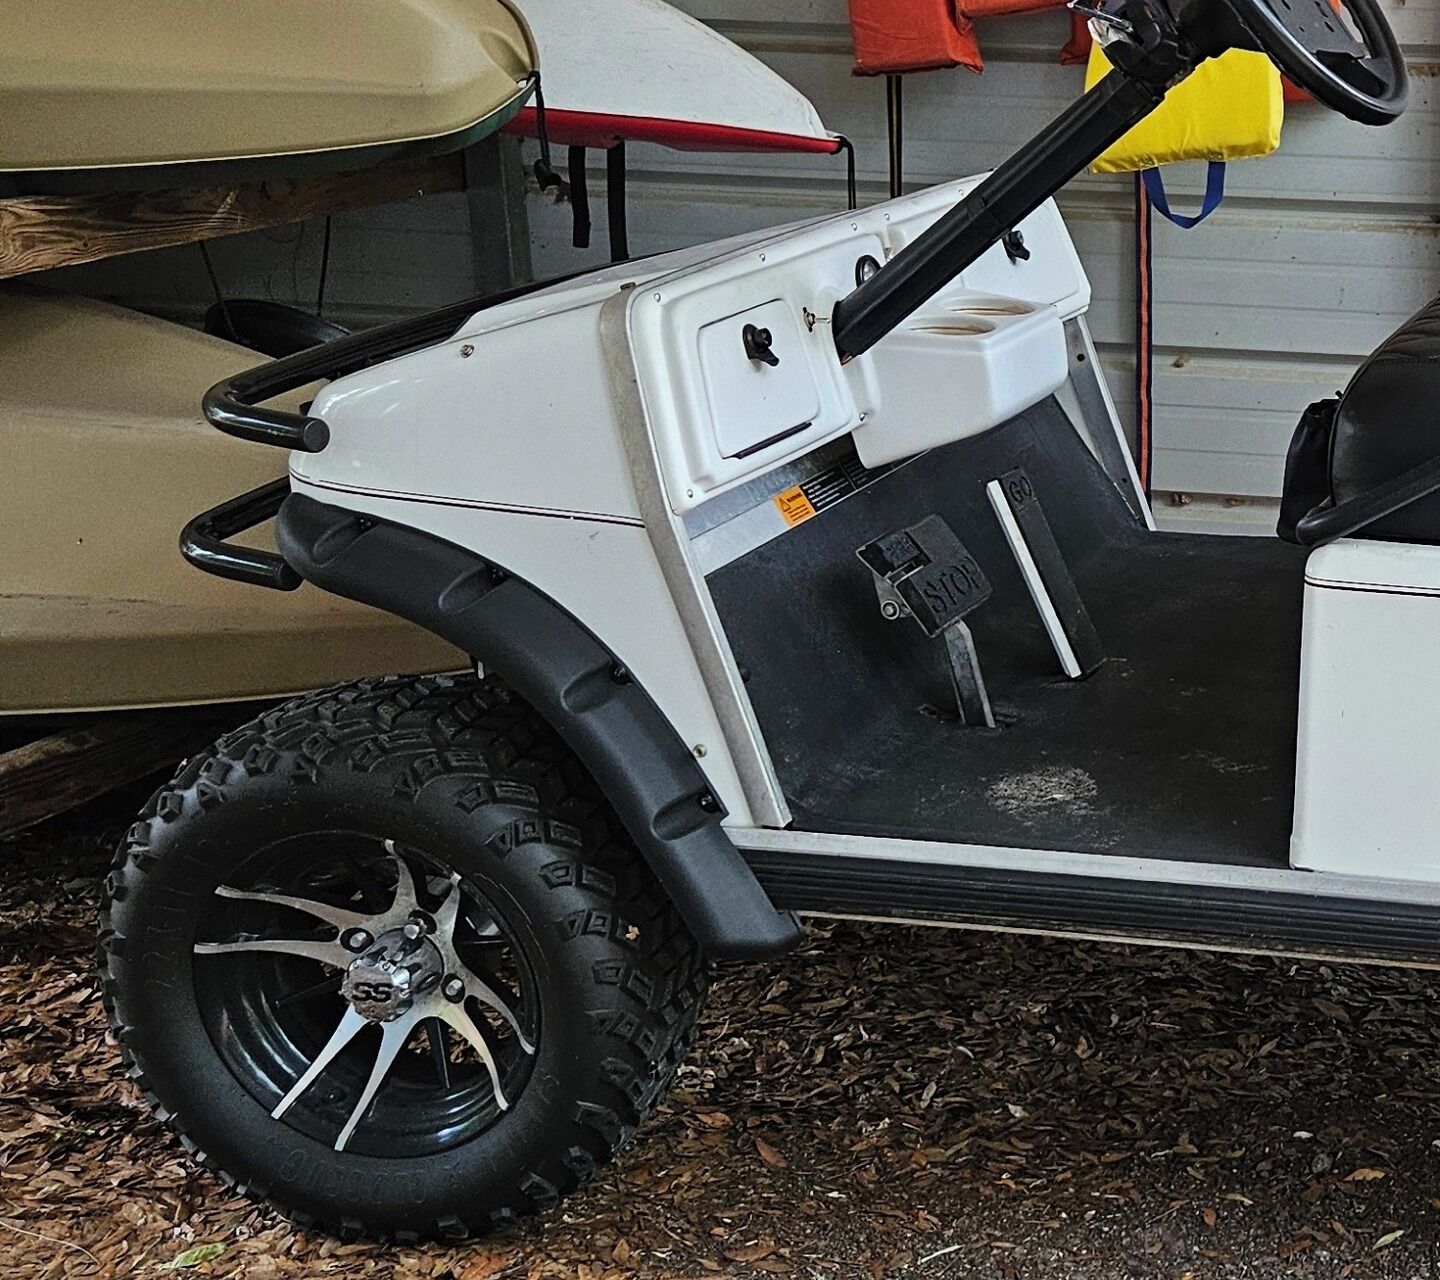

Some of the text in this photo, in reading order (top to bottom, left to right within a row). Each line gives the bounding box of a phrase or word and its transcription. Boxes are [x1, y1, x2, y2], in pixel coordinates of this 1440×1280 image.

[1009, 475, 1032, 503] GO
[924, 555, 982, 614] STOP
[352, 982, 394, 1003] SS
